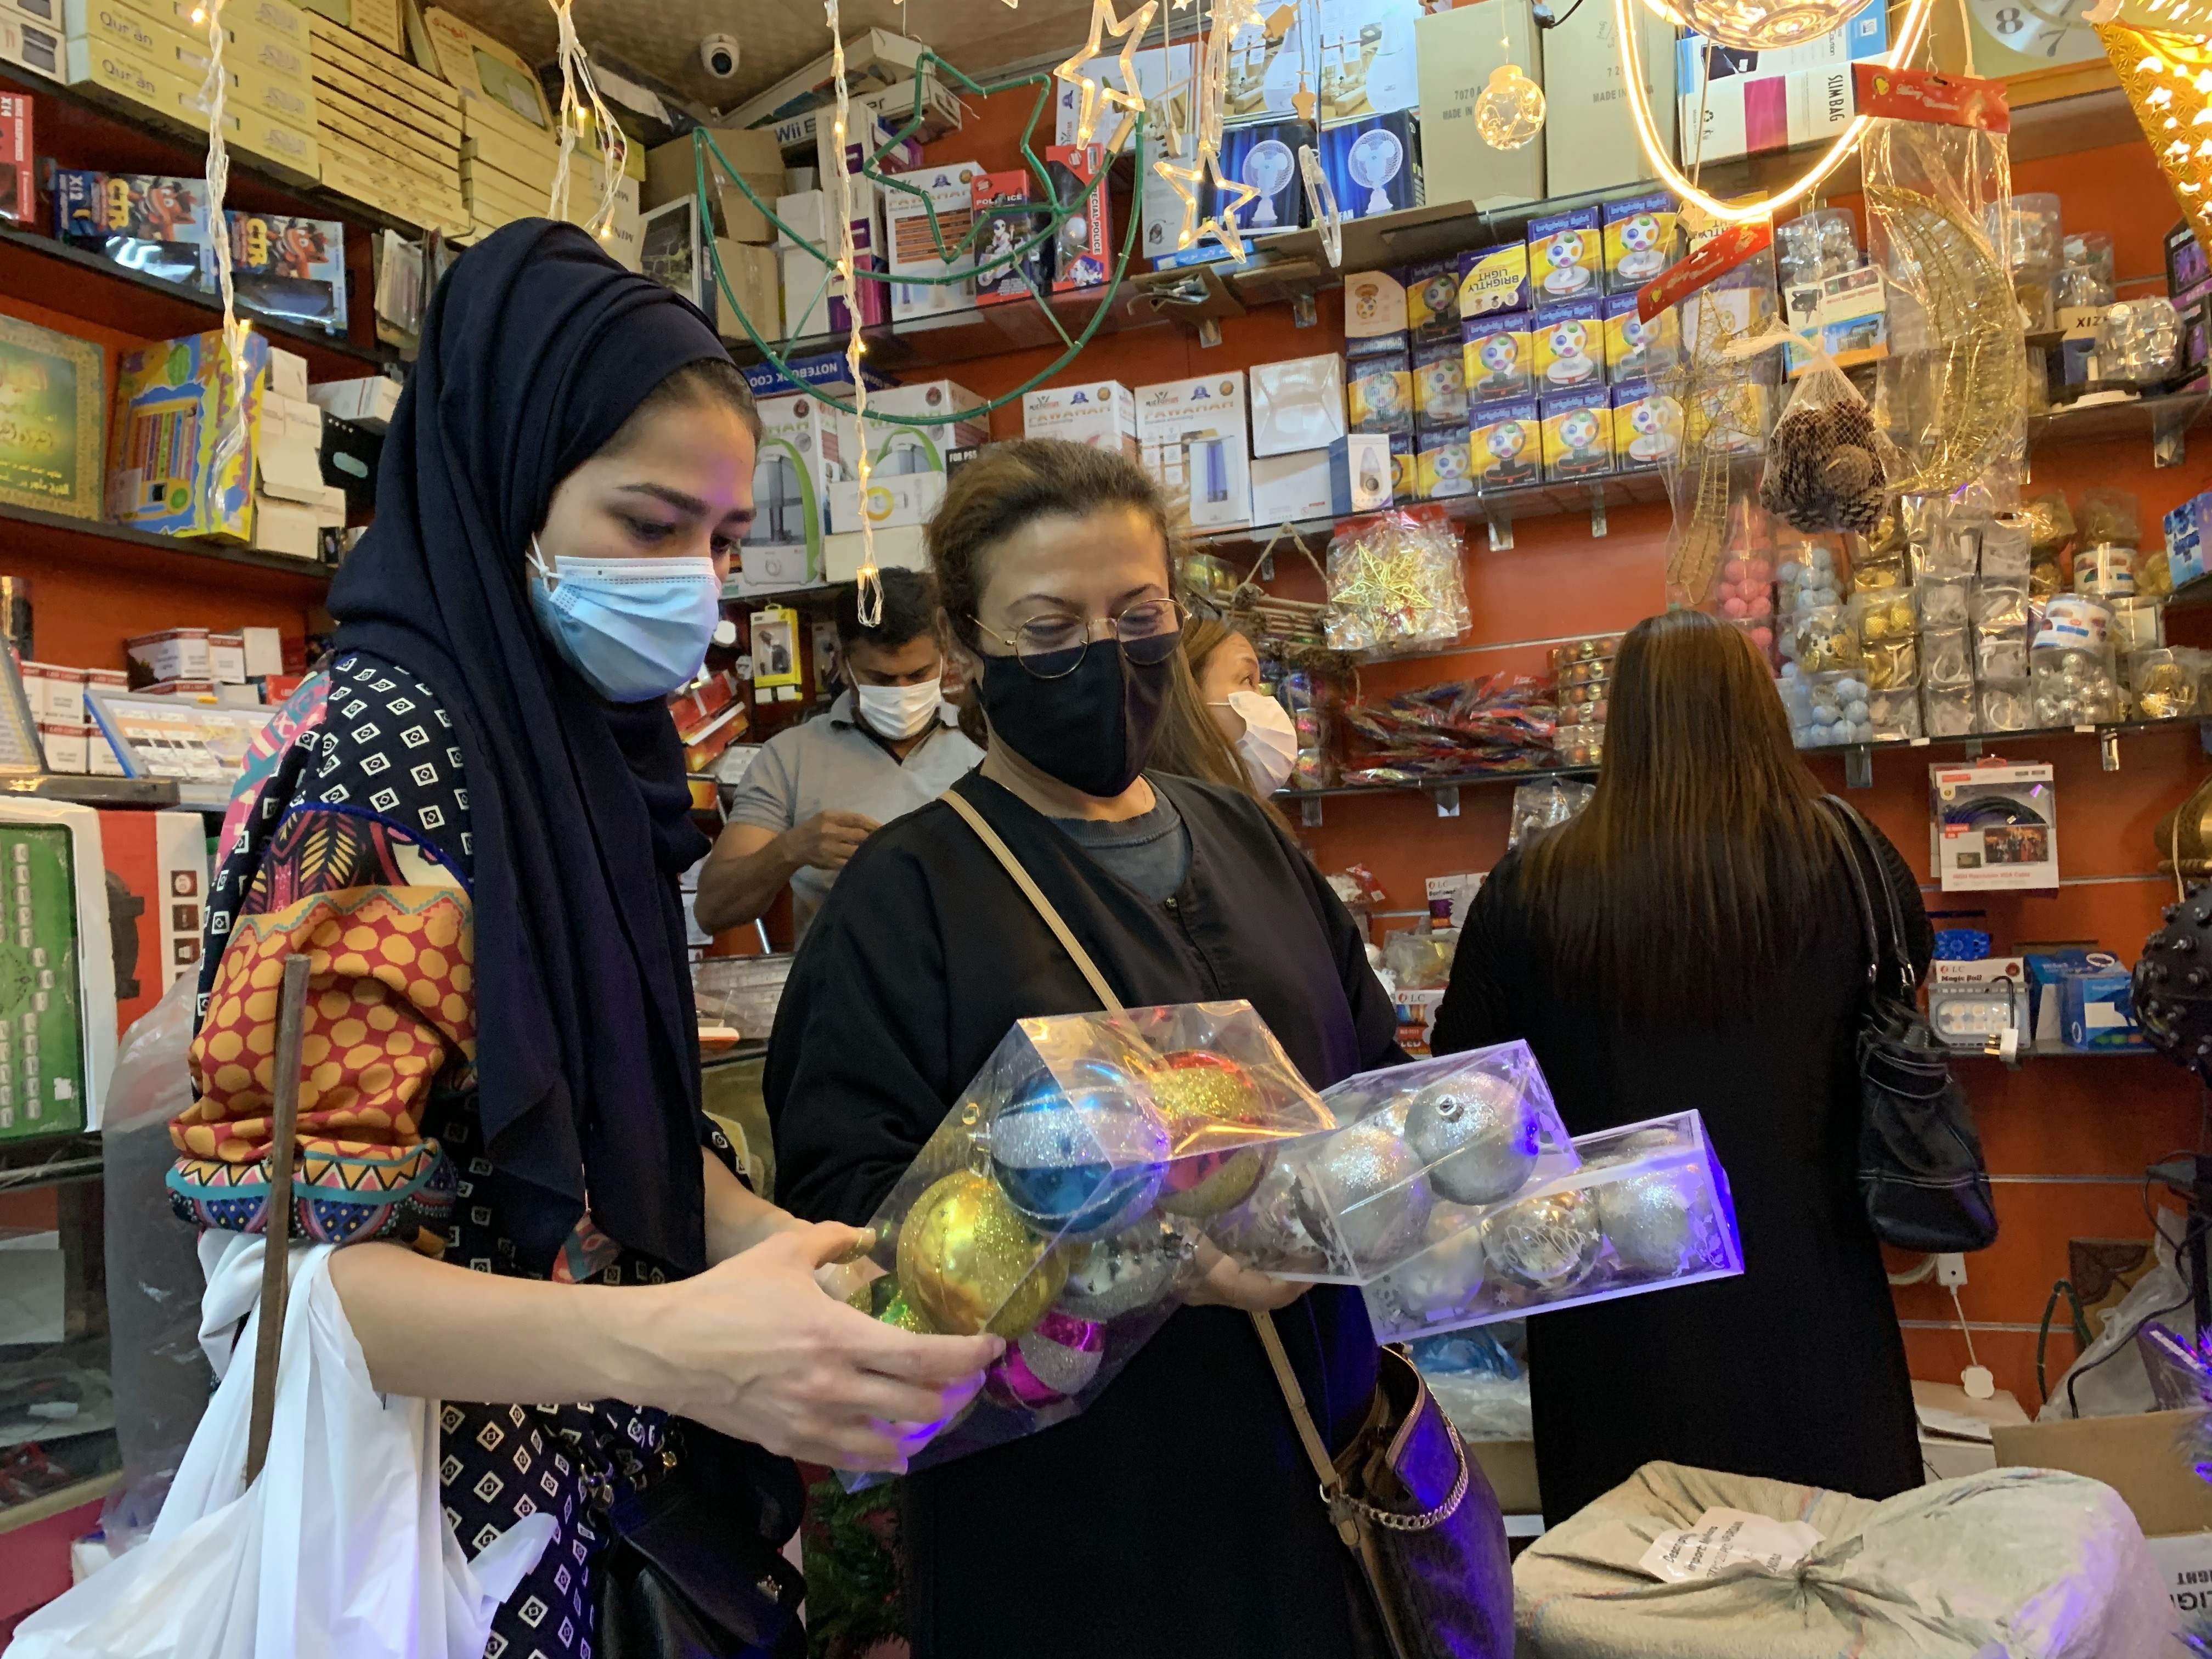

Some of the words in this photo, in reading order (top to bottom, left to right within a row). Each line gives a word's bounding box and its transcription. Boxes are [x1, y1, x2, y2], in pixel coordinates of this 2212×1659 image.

[1996, 8, 2023, 34] 8
[2039, 29, 2067, 57] 7
[1454, 88, 1475, 100] 7070
[1593, 90, 1616, 103] MADE
[1829, 75, 1843, 98] SLIM
[1829, 100, 1844, 122] BAG
[775, 121, 801, 142] Wii
[108, 178, 129, 230] CTR
[1091, 185, 1100, 219] PECIAL
[246, 218, 267, 268] CTR
[1092, 222, 1101, 255] POLICE
[1468, 275, 1519, 292] BRIGHTLY
[1478, 269, 1508, 281] LIGHT
[750, 375, 774, 387] COO
